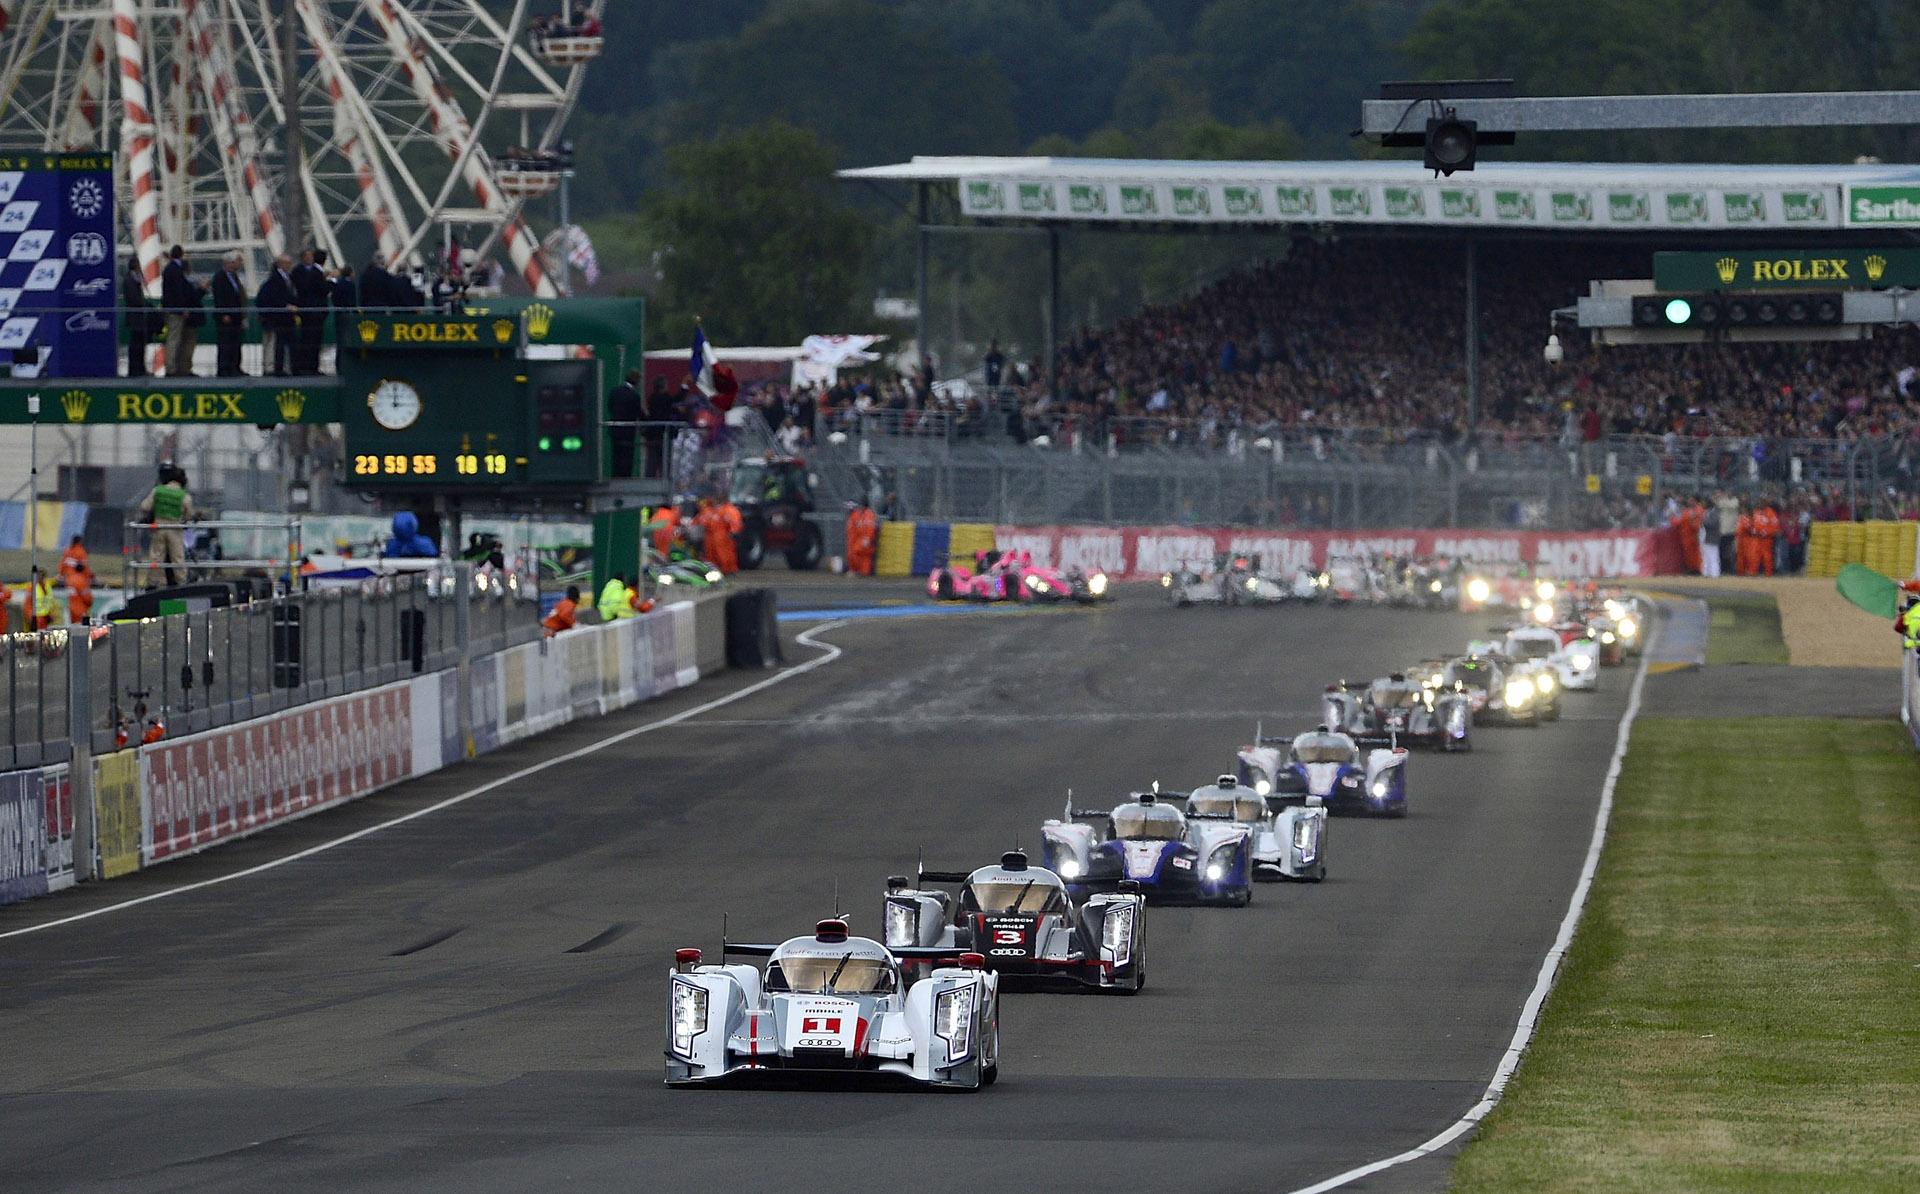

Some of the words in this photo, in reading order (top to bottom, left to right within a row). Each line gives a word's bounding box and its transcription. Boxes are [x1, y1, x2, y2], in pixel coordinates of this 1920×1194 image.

[4, 211, 24, 223] 24
[19, 239, 41, 251] 24
[69, 239, 104, 261] FIA
[35, 268, 56, 281] 24
[1753, 259, 1850, 281] ROLEX
[3, 327, 23, 339] 24
[392, 323, 480, 342] ROLEX
[117, 393, 247, 420] ROLEX
[354, 455, 380, 475] 23
[383, 455, 408, 475] 59
[412, 455, 437, 475] 55
[1537, 538, 1640, 577] MOTUL
[996, 930, 1022, 944] 3
[808, 1018, 835, 1034] 1
